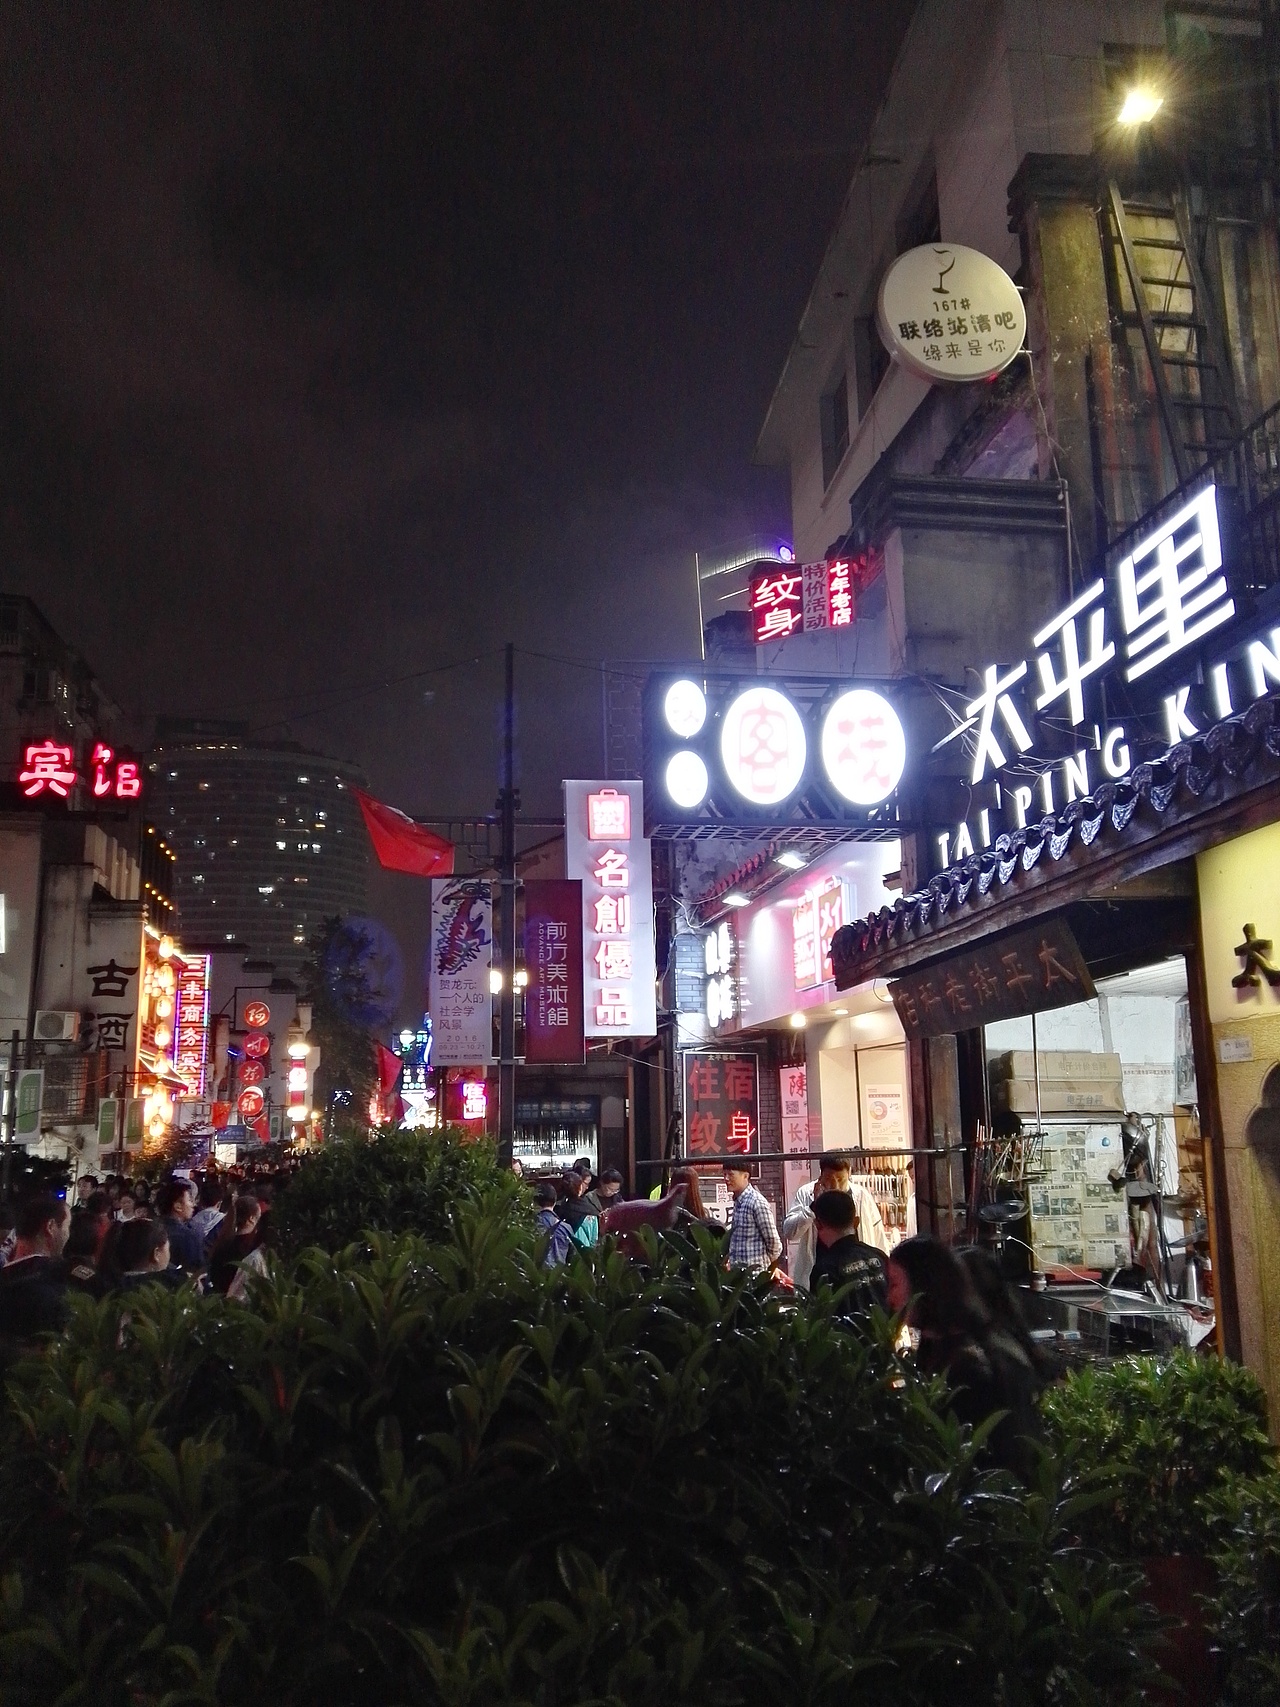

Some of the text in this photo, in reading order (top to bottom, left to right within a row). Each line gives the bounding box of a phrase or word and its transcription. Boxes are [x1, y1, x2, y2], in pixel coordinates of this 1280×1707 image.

[898, 311, 1017, 340] 联络站清吧
[932, 298, 971, 312] 167#
[923, 339, 1006, 360] 缘来是你
[754, 574, 802, 640] 纹身
[804, 563, 827, 629] 特价活动
[830, 561, 852, 625] 七年老店
[966, 483, 1235, 785] 太平里
[594, 849, 633, 1026] 名創優品
[546, 922, 569, 1026] 前行美術館
[439, 992, 484, 1004] 一个人的
[439, 1005, 475, 1017] 社会学
[438, 1019, 462, 1030] 风景
[688, 1059, 754, 1100] 住宿
[690, 1110, 756, 1154] 纹身
